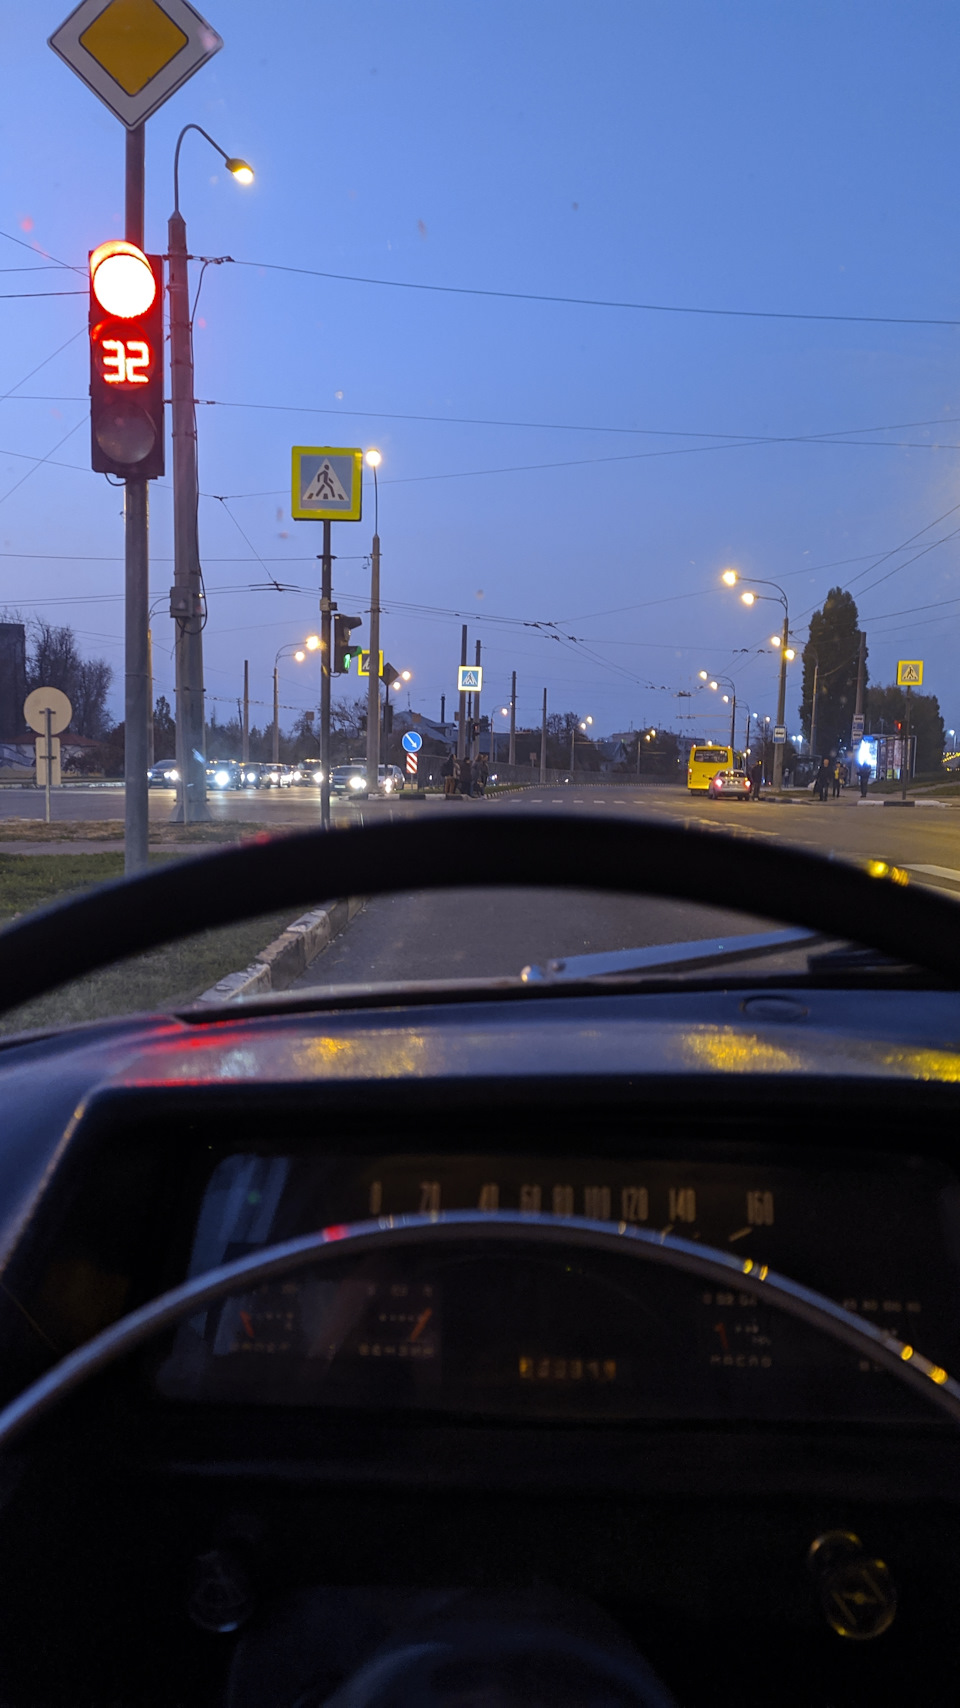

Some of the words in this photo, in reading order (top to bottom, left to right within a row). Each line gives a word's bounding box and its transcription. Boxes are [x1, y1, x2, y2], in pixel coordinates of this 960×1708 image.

[101, 340, 150, 383] 32
[621, 1186, 649, 1221] 120
[669, 1187, 696, 1223] 140
[746, 1190, 774, 1226] 160
